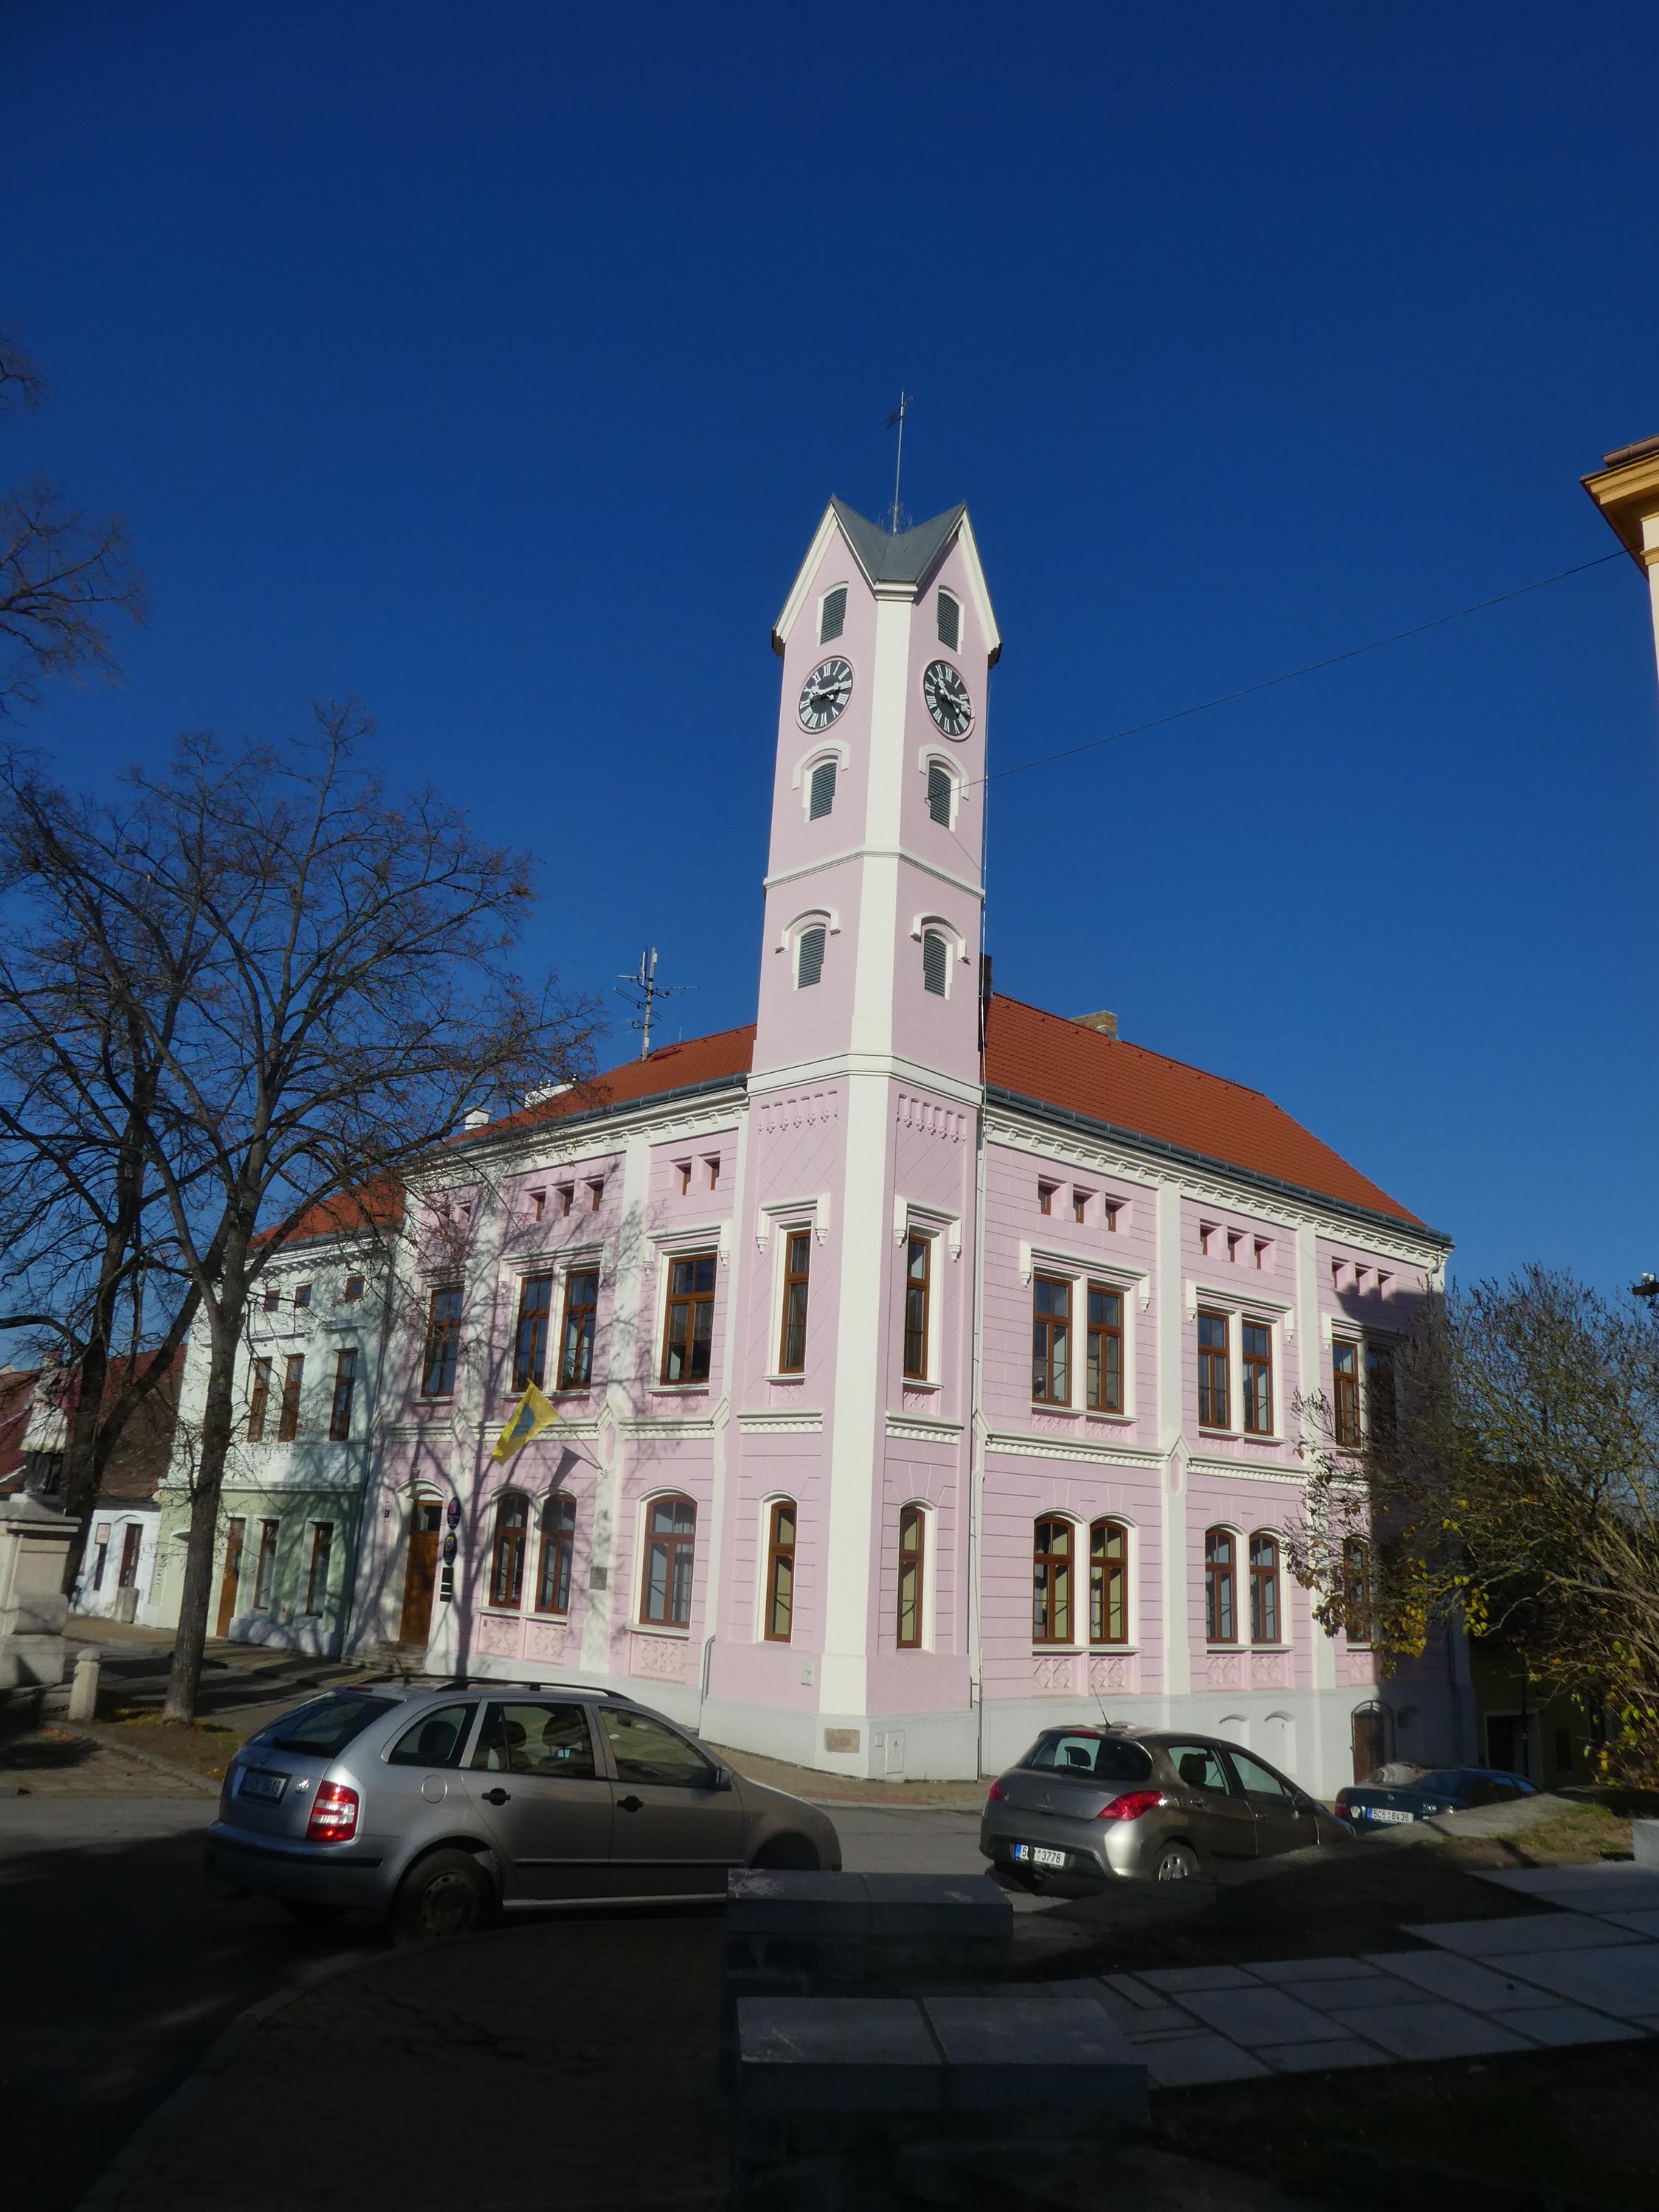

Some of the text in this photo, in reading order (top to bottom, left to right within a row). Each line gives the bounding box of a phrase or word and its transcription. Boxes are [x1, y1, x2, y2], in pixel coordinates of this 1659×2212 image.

[822, 662, 832, 678] XII
[838, 667, 850, 681] II
[928, 669, 938, 685] X
[935, 664, 944, 679] XI
[945, 667, 953, 683] XII
[812, 671, 821, 686] XI
[831, 706, 840, 718] V
[819, 712, 827, 728] VI
[943, 717, 950, 733] VI
[953, 720, 960, 734] V
[1042, 1851, 1061, 1863] 3778
